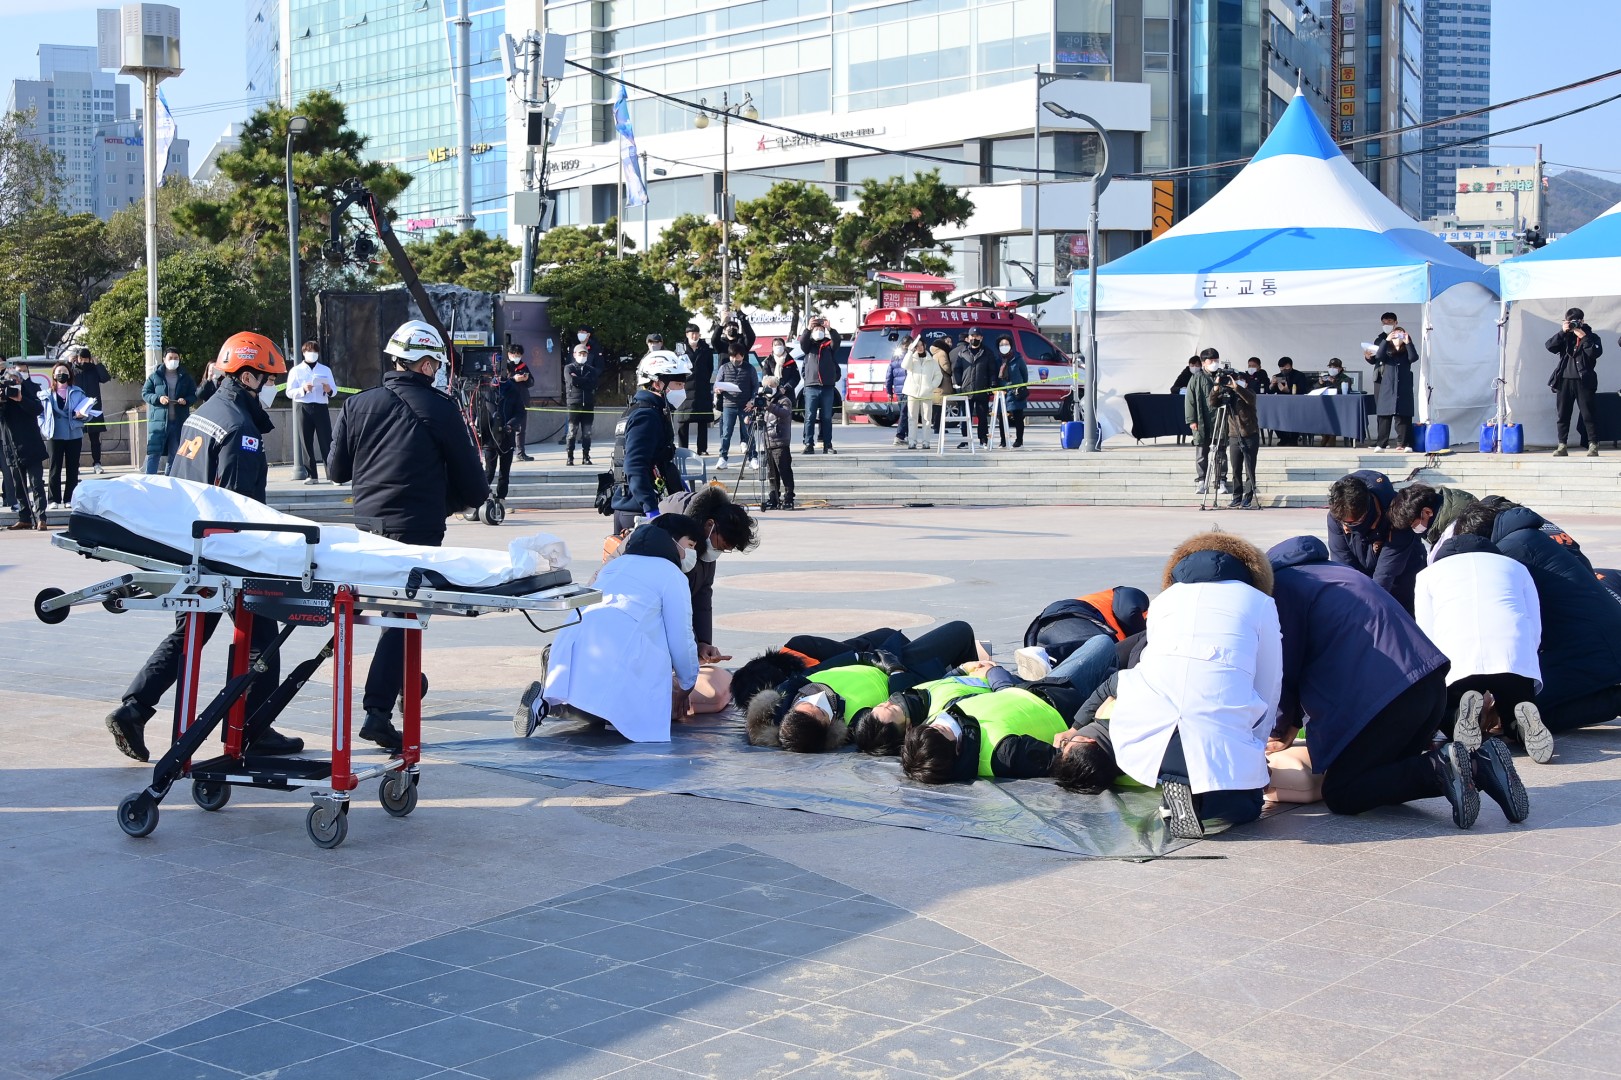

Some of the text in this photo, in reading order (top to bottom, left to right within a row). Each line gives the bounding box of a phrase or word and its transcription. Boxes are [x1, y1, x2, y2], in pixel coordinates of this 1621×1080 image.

[104, 137, 124, 145] HOTEL
[429, 147, 447, 163] MS
[561, 159, 580, 170] 1899
[1153, 186, 1174, 229] 277
[1438, 230, 1508, 241] 활의학과의원
[940, 311, 979, 321] 지휘본부
[91, 581, 115, 592] AUTECH
[288, 613, 326, 622] AUTECH
